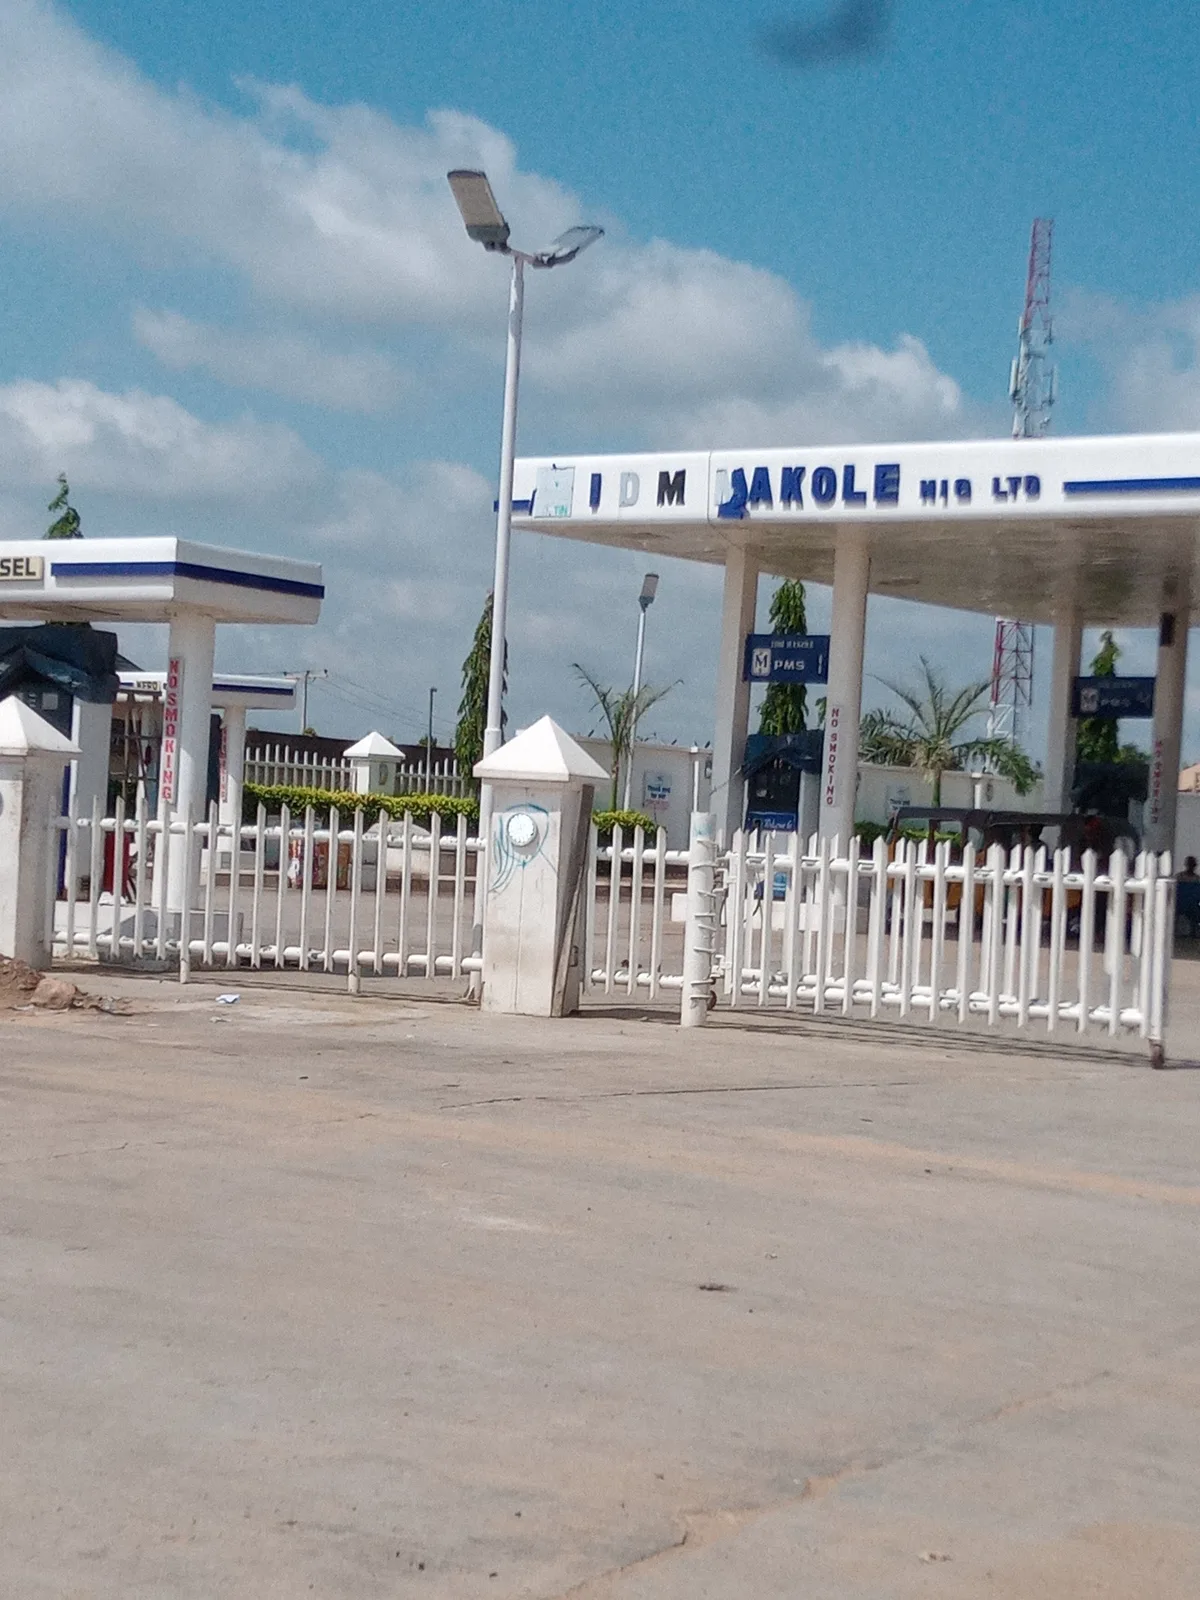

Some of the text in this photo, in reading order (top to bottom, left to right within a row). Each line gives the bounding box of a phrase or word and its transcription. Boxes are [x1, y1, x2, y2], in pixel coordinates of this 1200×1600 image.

[774, 660, 805, 671] PMS
[162, 660, 179, 799] NO SMOKING
[826, 708, 839, 805] NO SMOKING
